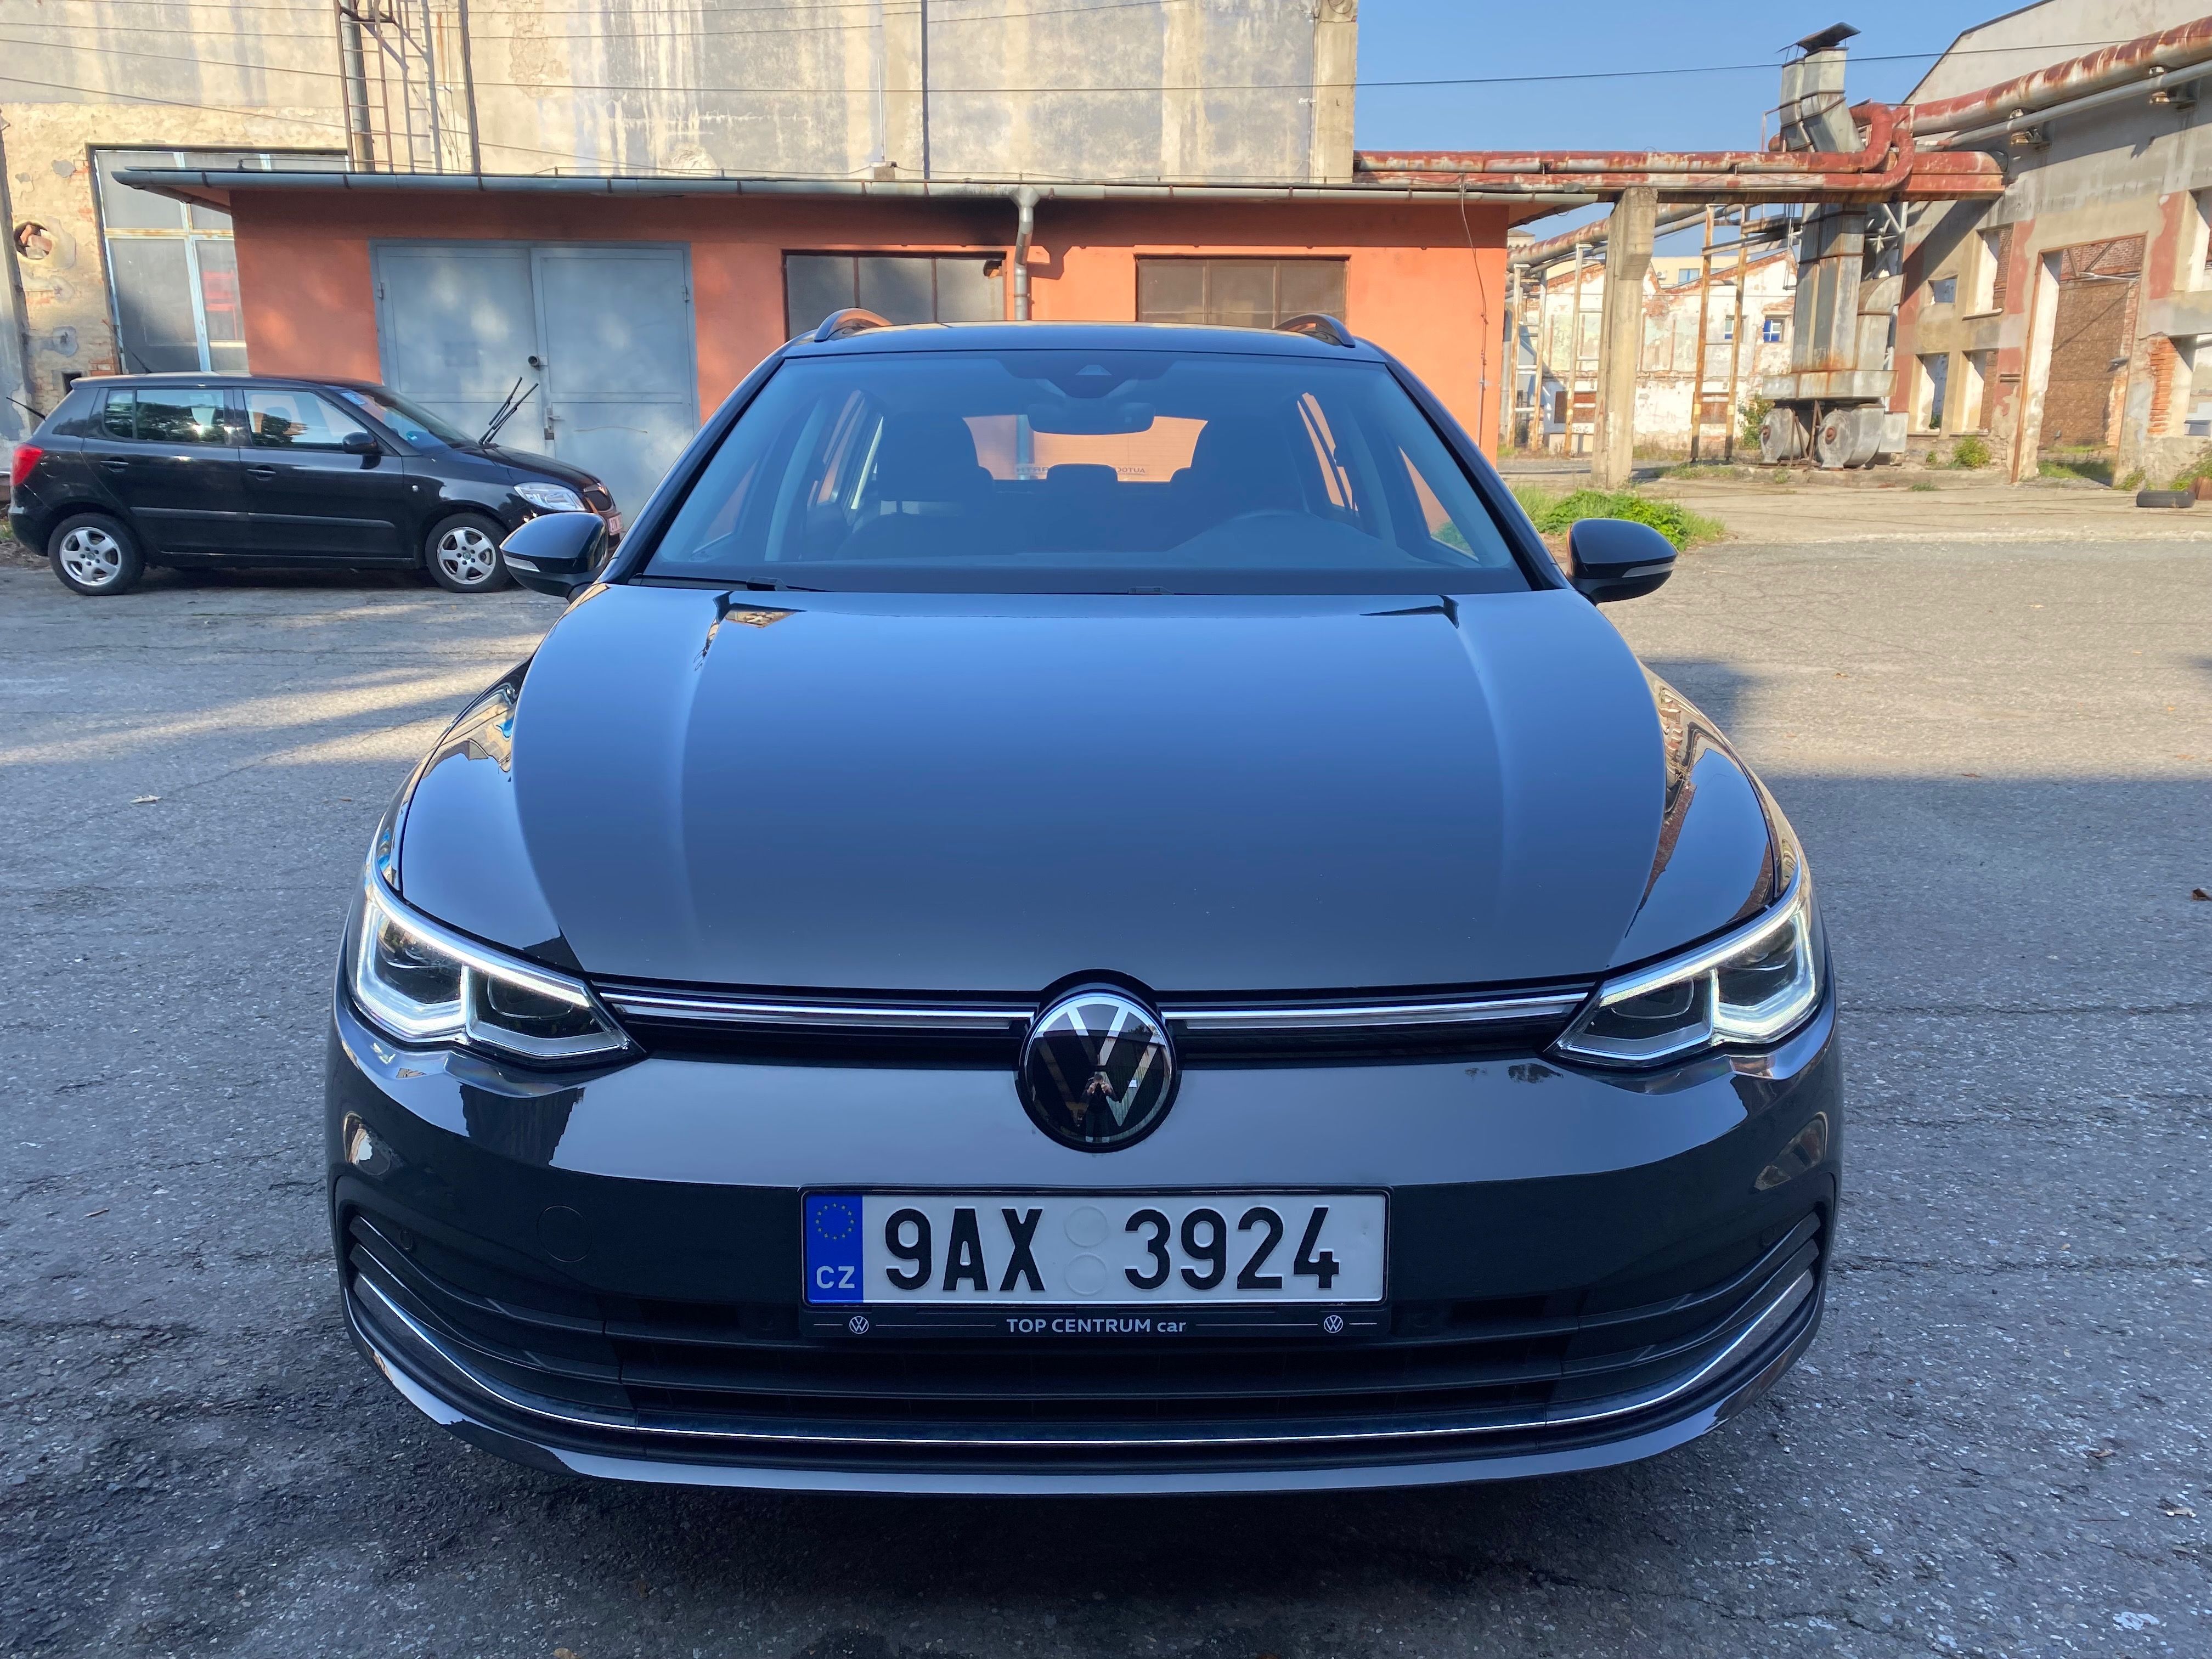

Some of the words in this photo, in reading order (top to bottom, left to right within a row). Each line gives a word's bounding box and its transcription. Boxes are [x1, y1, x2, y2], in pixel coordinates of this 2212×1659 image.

[885, 1207, 1046, 1291] 9AX
[1125, 1206, 1340, 1290] 3924
[816, 1266, 855, 1289] CZ
[1006, 1318, 1047, 1333] TOP
[1052, 1318, 1150, 1333] CENTRUM
[1156, 1321, 1187, 1333] car
